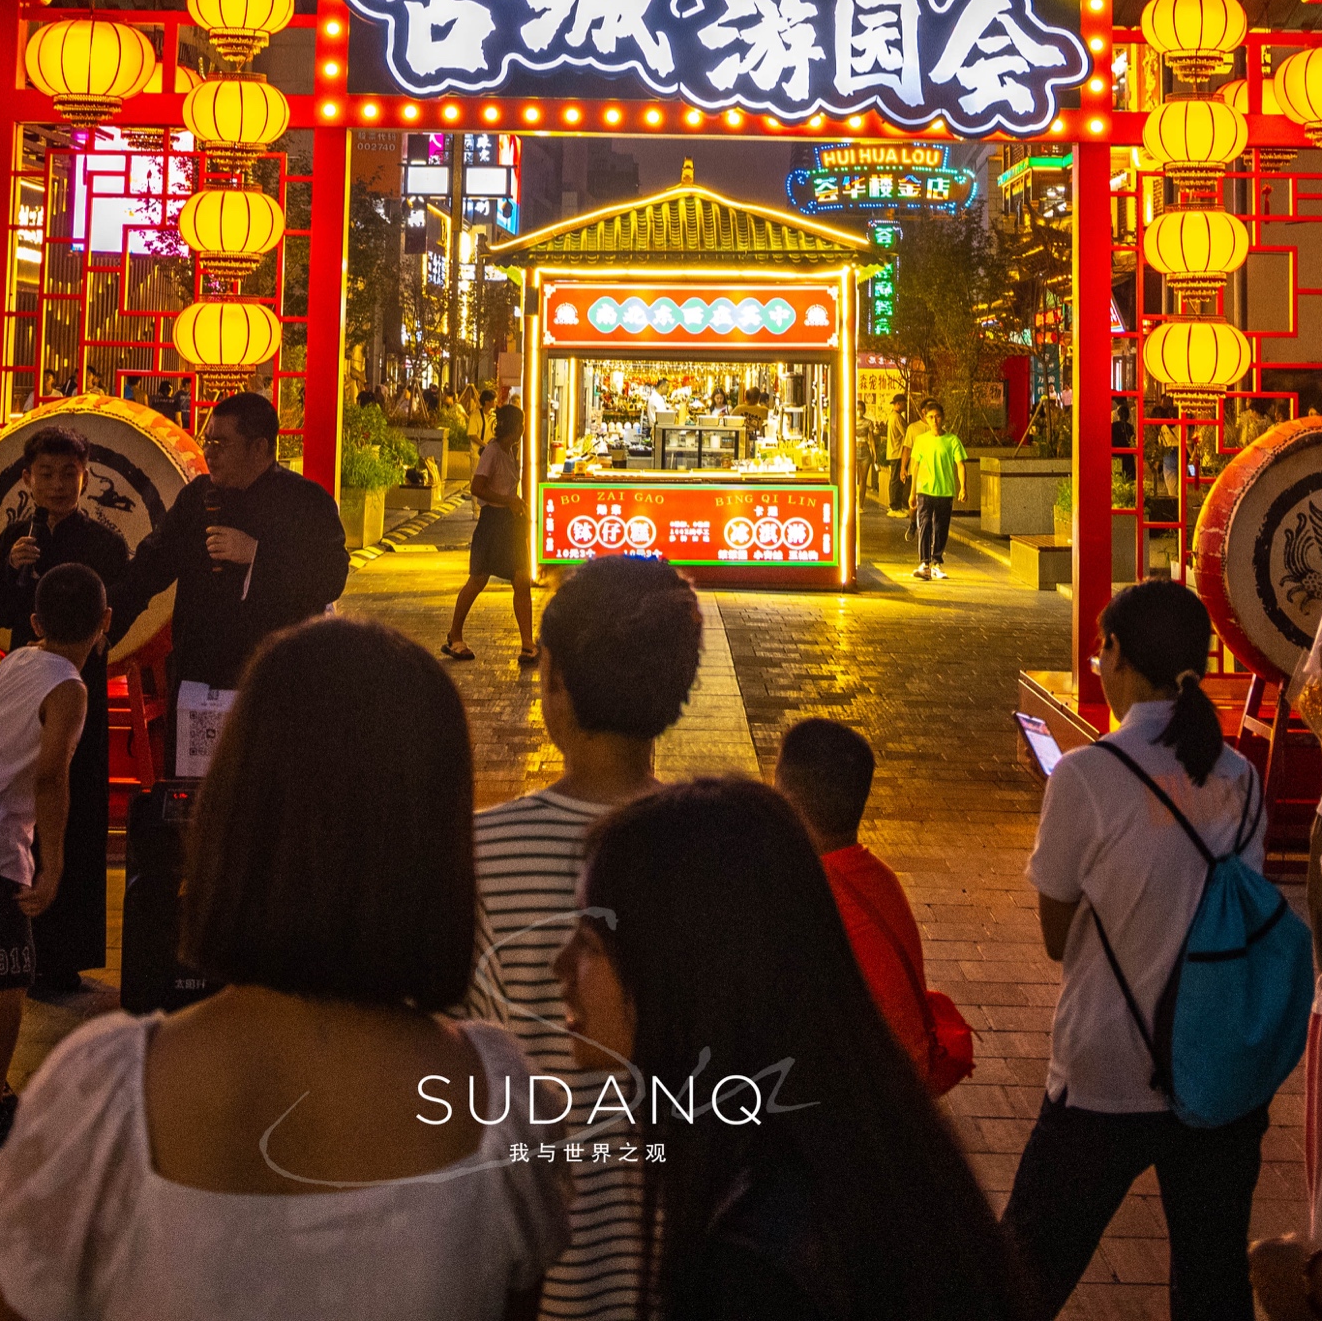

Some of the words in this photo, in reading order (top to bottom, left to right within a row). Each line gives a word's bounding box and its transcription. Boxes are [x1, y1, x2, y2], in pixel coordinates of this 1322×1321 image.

[357, 142, 396, 151] 002740
[823, 150, 855, 167] HUI
[859, 148, 899, 165] HUA
[901, 148, 940, 166] LOU
[813, 174, 951, 203] 荟华楼金店
[560, 493, 581, 506] BO
[596, 491, 626, 502] ZAI
[634, 492, 665, 505] GAO
[714, 494, 754, 507] BING
[761, 494, 779, 504] QI
[787, 495, 817, 508] LIN
[729, 522, 807, 544] 冰淇淋
